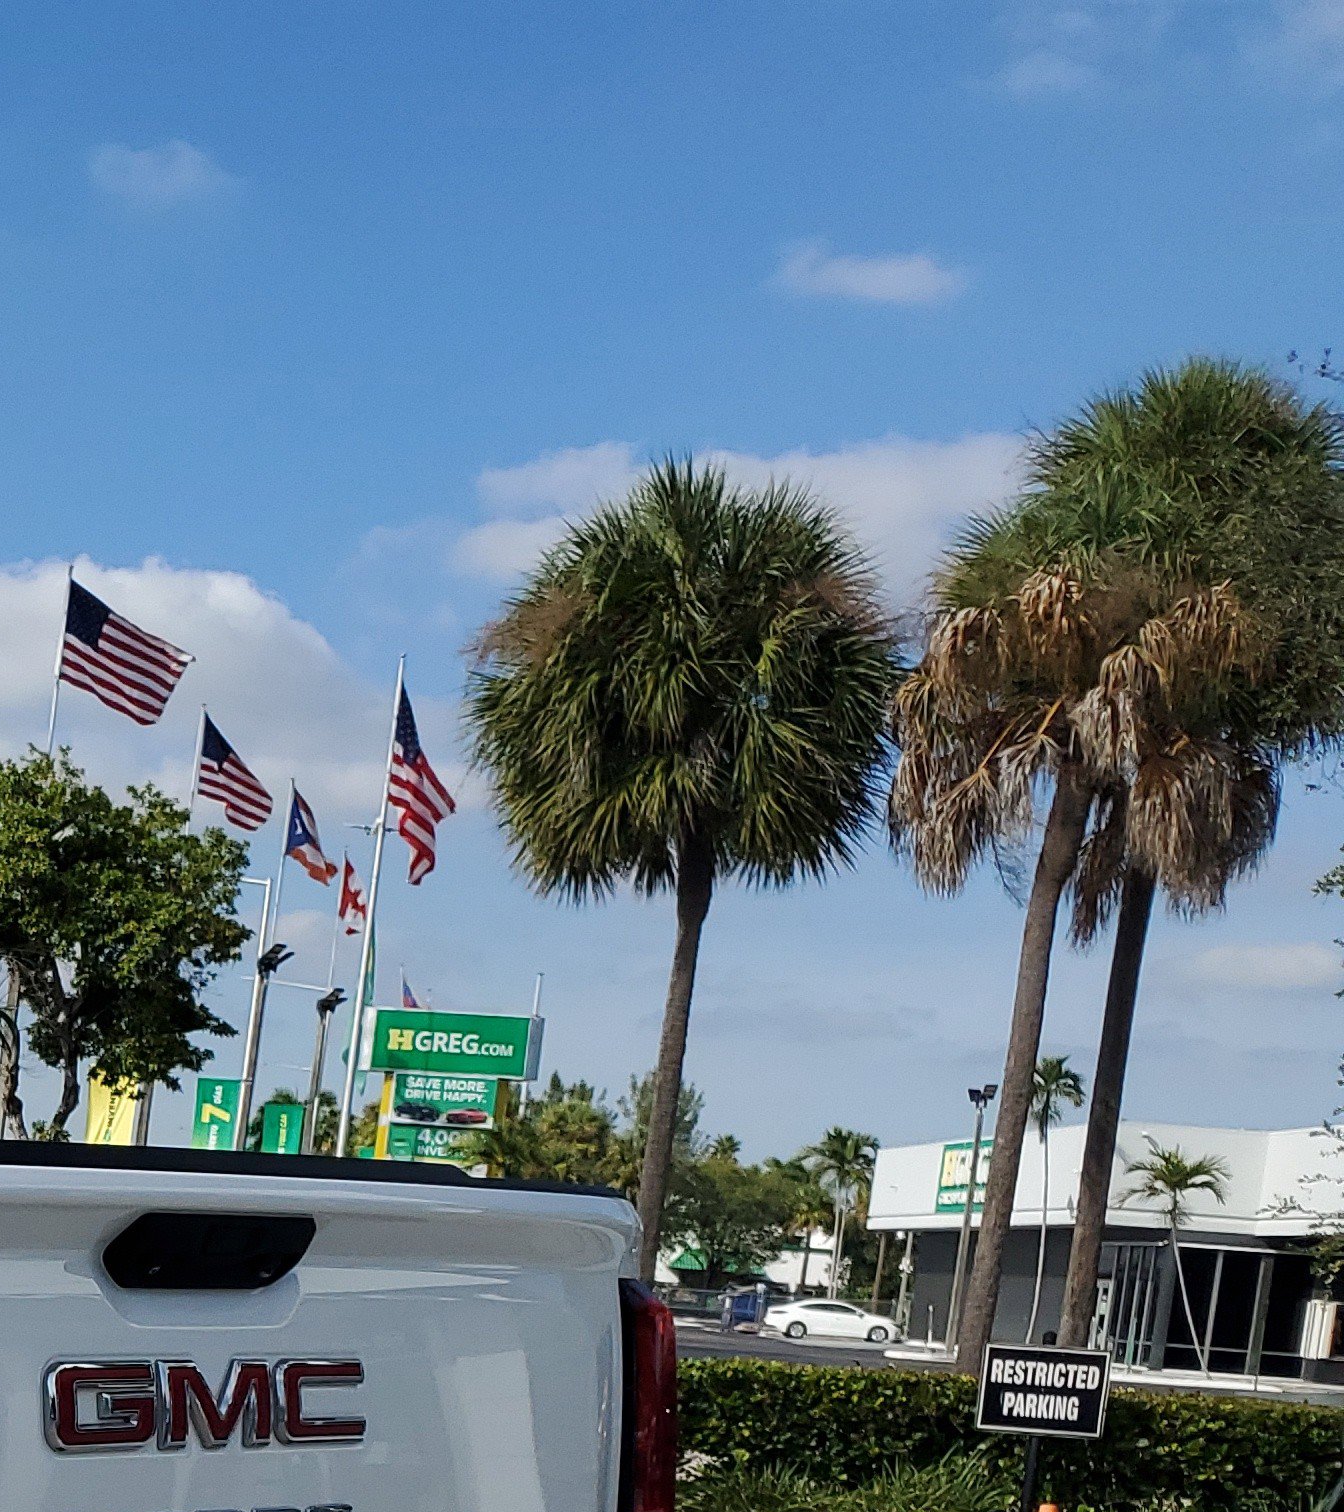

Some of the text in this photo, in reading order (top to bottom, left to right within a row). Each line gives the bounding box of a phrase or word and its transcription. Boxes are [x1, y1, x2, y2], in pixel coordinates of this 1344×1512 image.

[404, 1088, 441, 1101] DRIVE
[200, 1102, 231, 1124] 7
[990, 1357, 1101, 1391] RESTRICTED
[40, 1356, 368, 1456] GMC
[1001, 1391, 1080, 1422] PARKING
